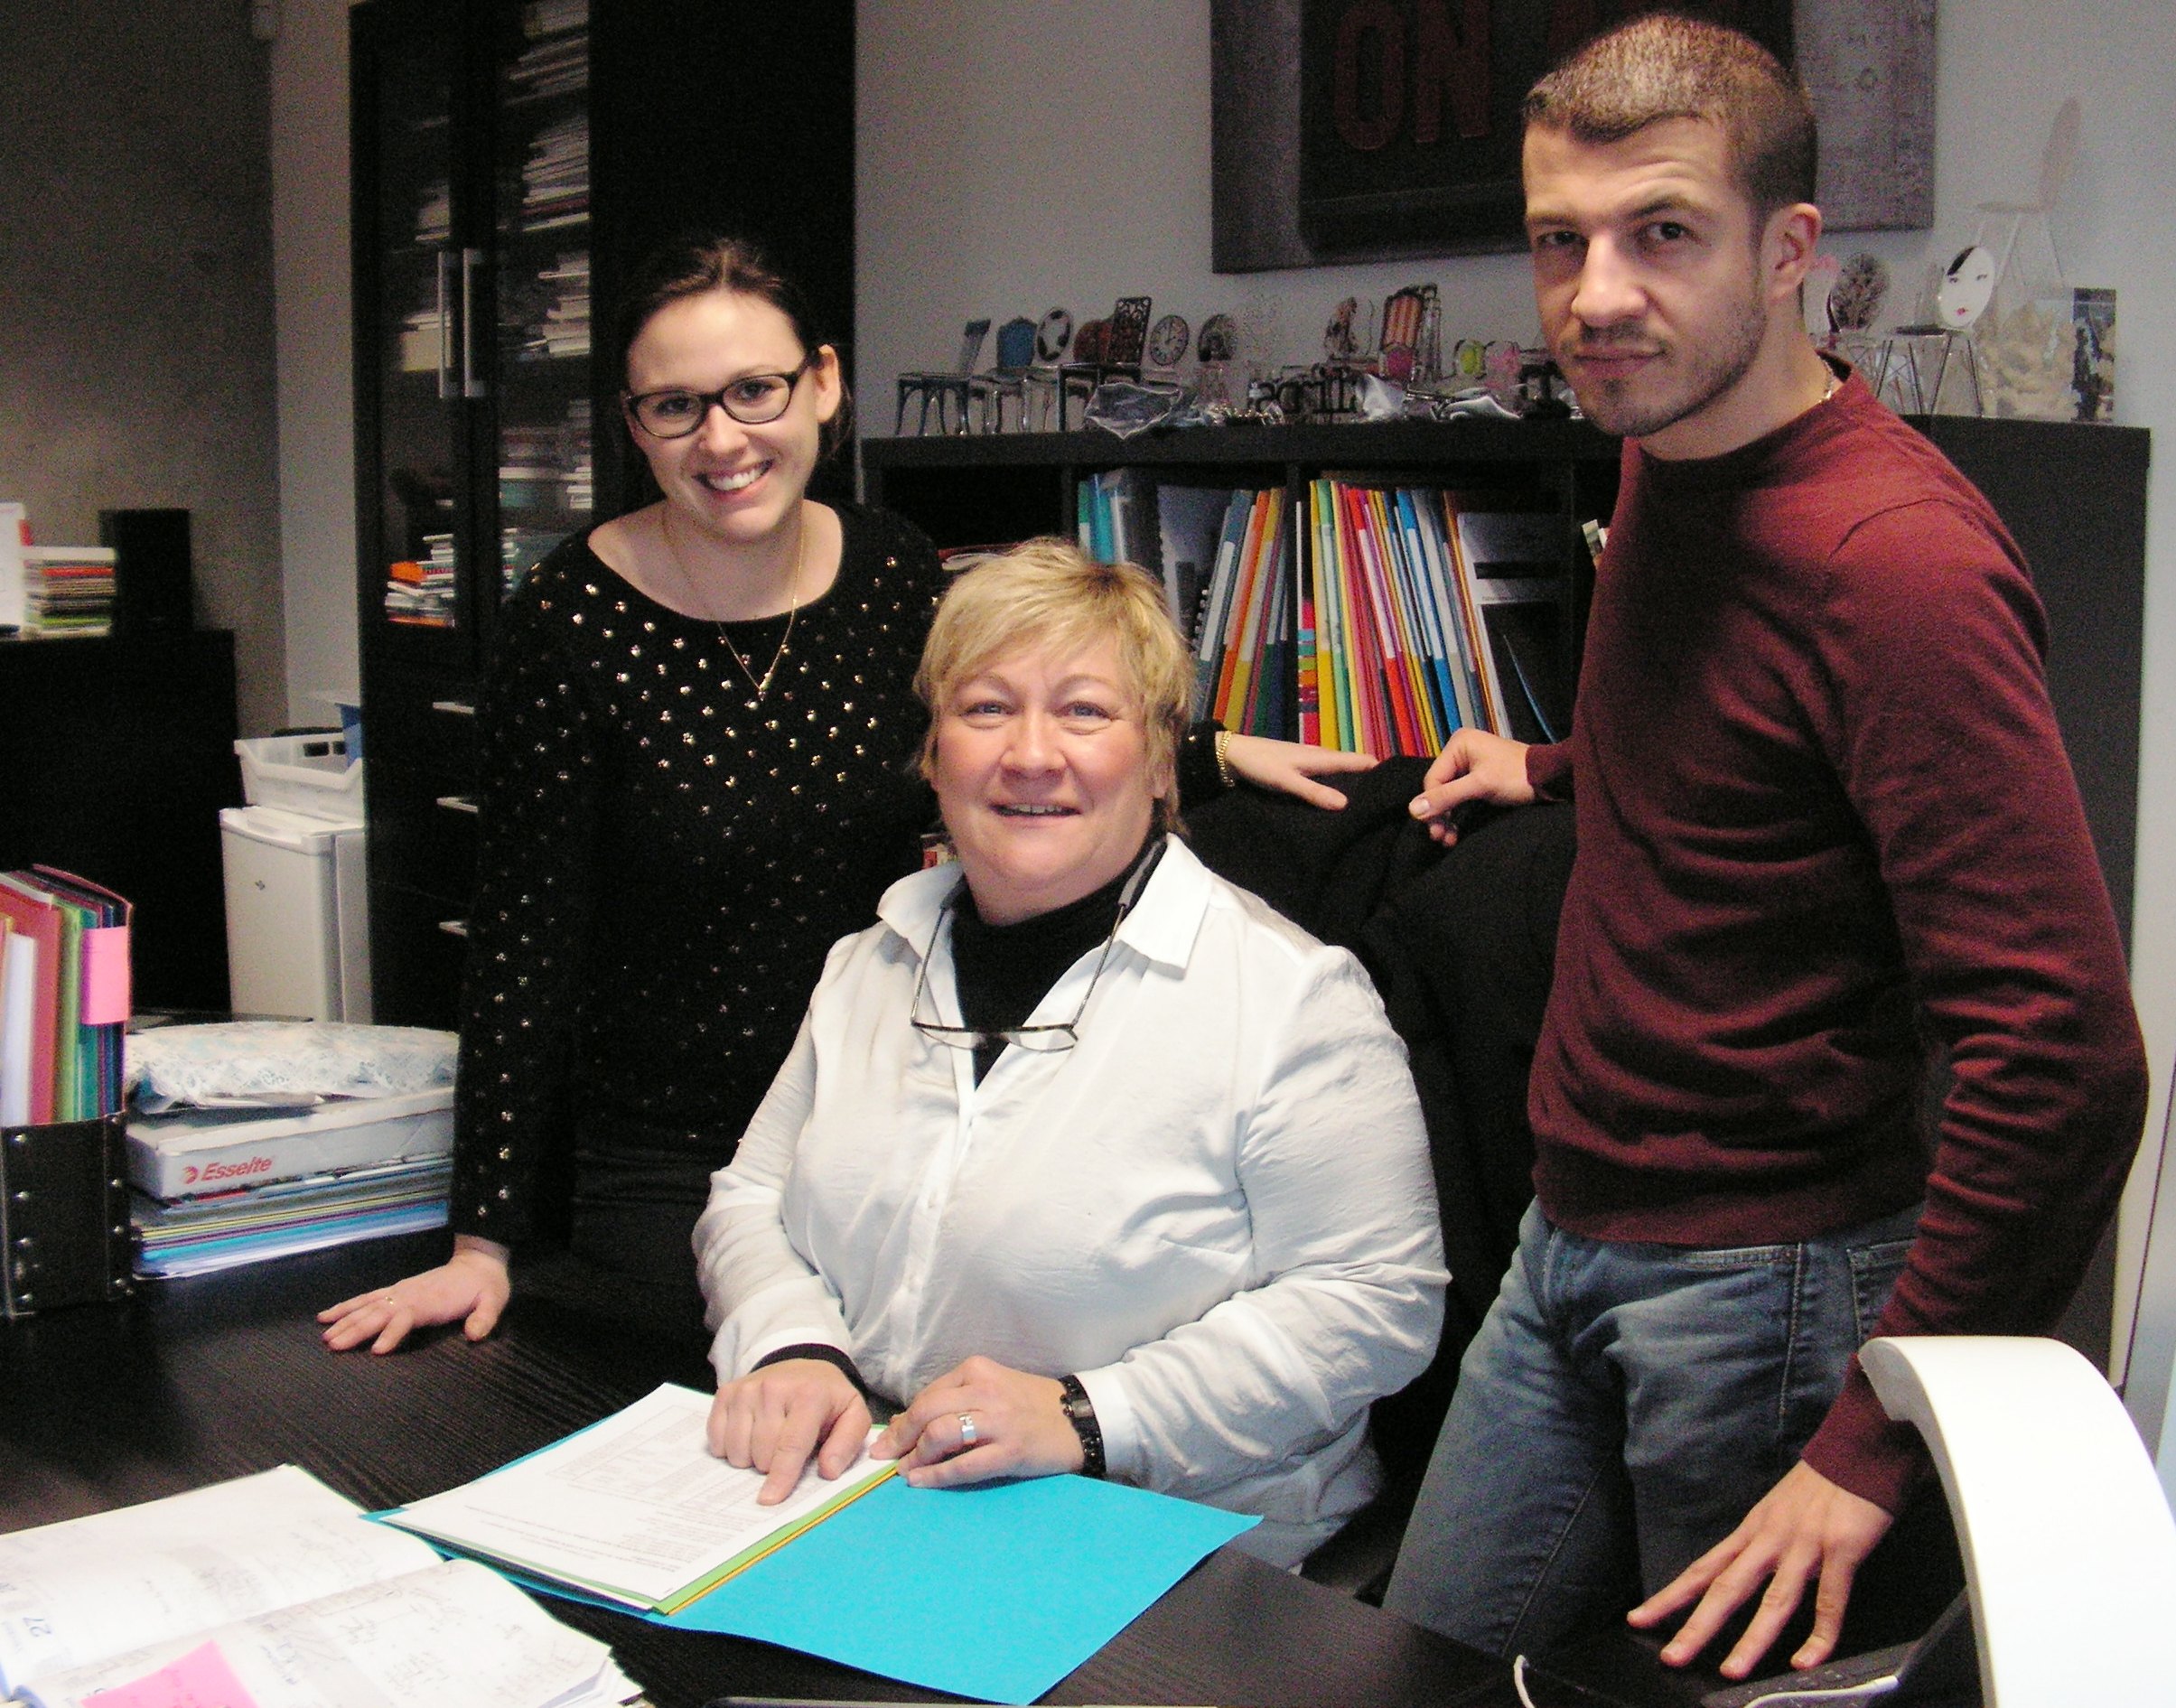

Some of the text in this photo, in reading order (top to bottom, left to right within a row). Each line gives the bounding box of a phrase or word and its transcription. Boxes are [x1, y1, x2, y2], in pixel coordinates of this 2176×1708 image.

[1333, 0, 1492, 150] ON
[202, 1156, 272, 1181] Esselte
[22, 1617, 51, 1638] 27
